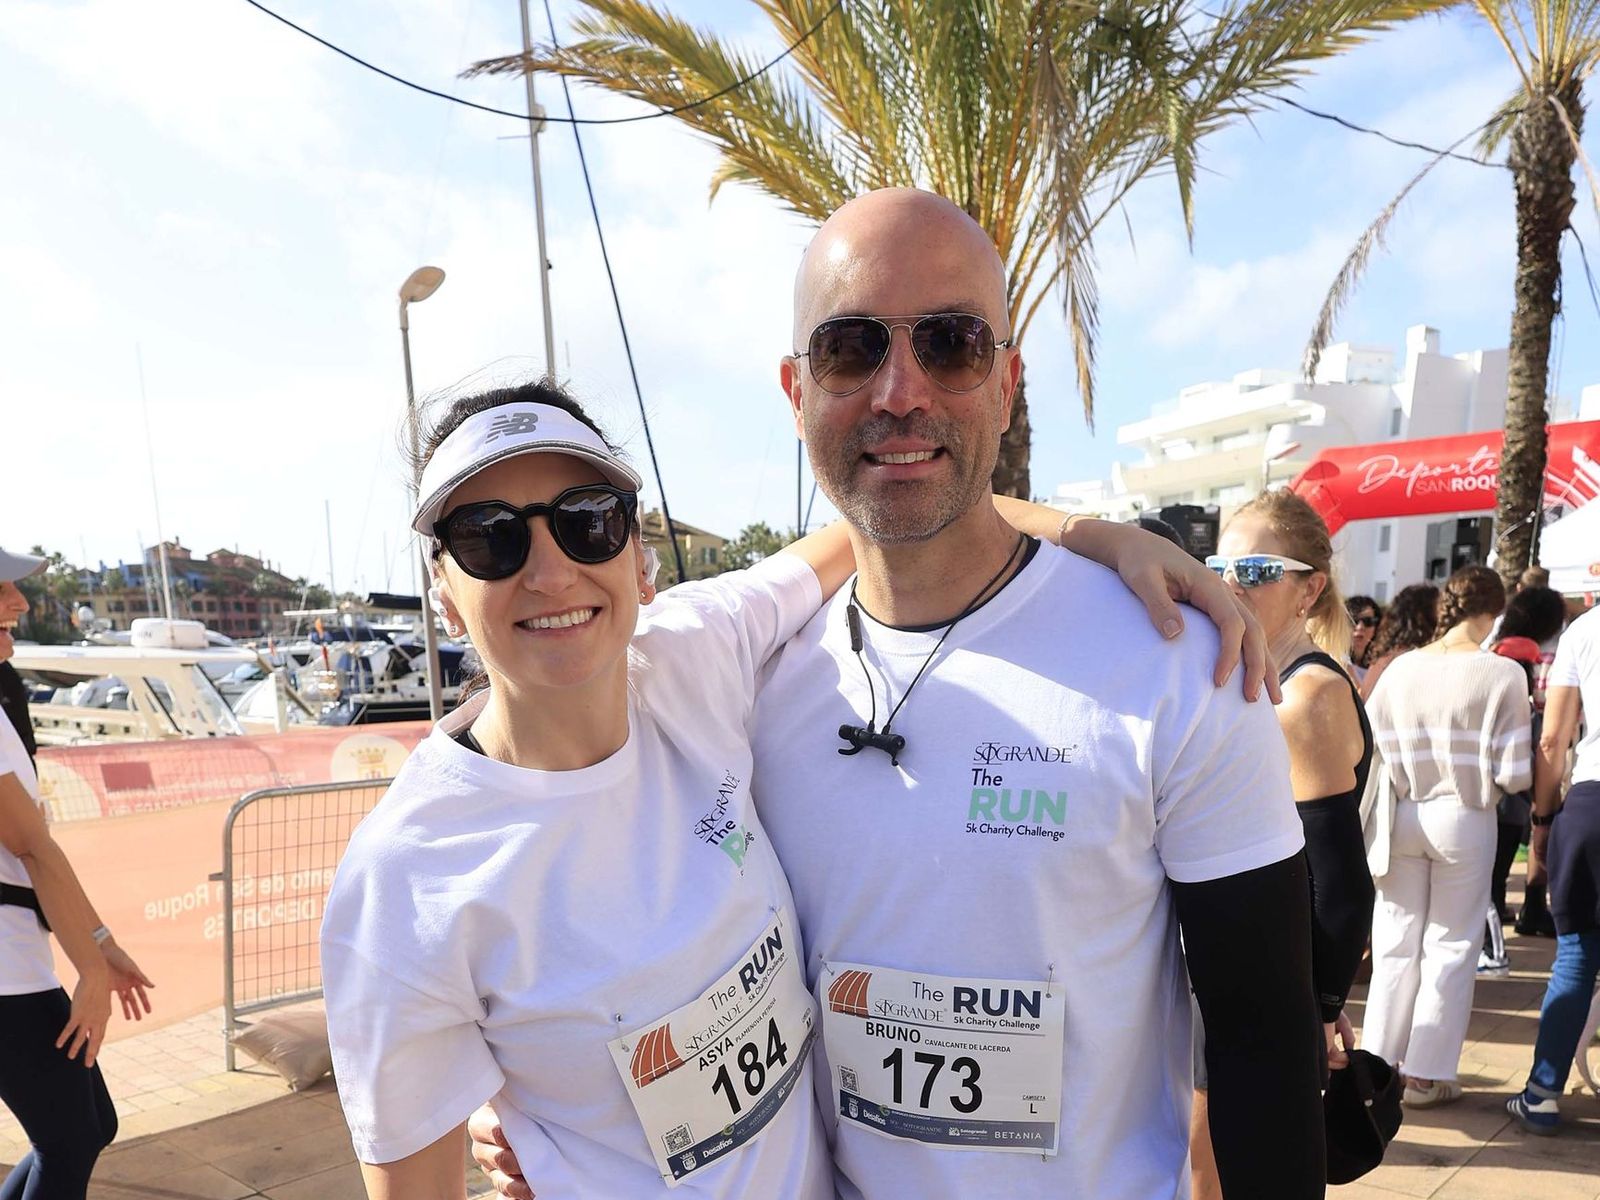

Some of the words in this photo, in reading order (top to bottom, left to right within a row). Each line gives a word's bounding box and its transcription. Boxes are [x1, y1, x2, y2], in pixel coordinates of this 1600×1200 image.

[971, 768, 1003, 786] The
[968, 788, 1068, 825] RUN
[706, 820, 736, 846] The
[965, 822, 977, 834] 5k
[979, 823, 1014, 838] Charity
[1016, 825, 1065, 841] Challenge
[708, 985, 737, 1011] The
[738, 926, 783, 994] RUN
[912, 981, 944, 1002] The
[953, 986, 1041, 1019] RUN
[866, 1021, 921, 1043] BRUNO
[925, 1039, 968, 1050] CAVALCANTE
[979, 1044, 1011, 1053] LACERDA
[953, 1016, 964, 1025] 5k
[966, 1017, 997, 1028] Charity
[999, 1019, 1041, 1031] Challenge
[699, 1036, 734, 1071] ASYA
[735, 1014, 763, 1043] PLAMENOVA
[711, 1016, 787, 1115] 184
[883, 1047, 983, 1114] 173
[1030, 1103, 1037, 1114] L
[994, 1131, 1042, 1140] BETANIA
